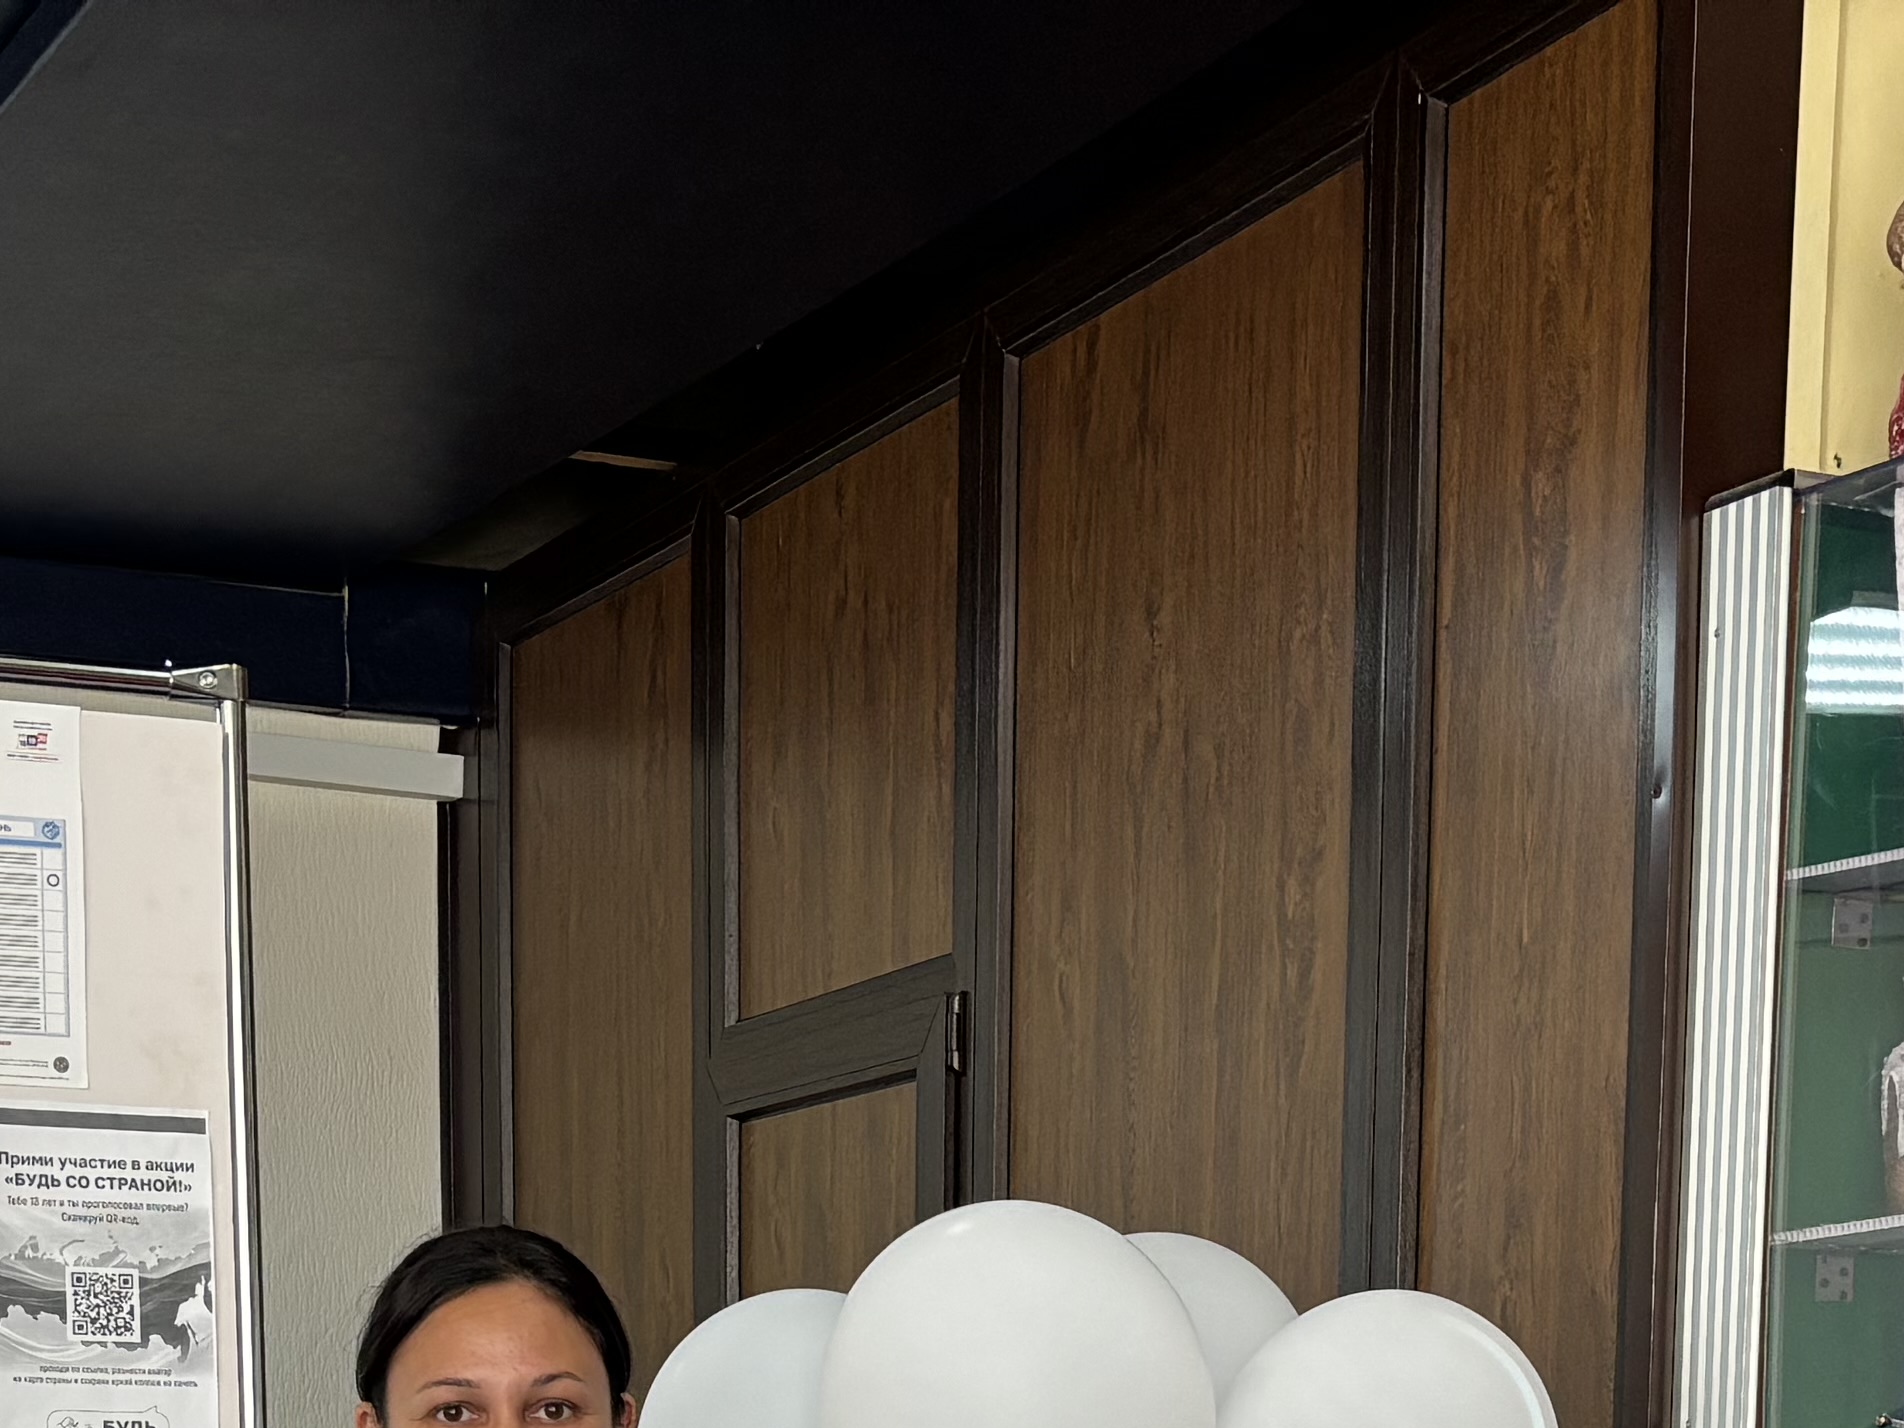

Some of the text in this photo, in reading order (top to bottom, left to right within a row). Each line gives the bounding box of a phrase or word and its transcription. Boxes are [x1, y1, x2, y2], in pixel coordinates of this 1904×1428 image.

[57, 1157, 128, 1171] участие
[131, 1159, 141, 1171] в
[144, 1160, 195, 1174] акции
[4, 1172, 192, 1193] «БУДЬ СО СТРАНОЙ!»
